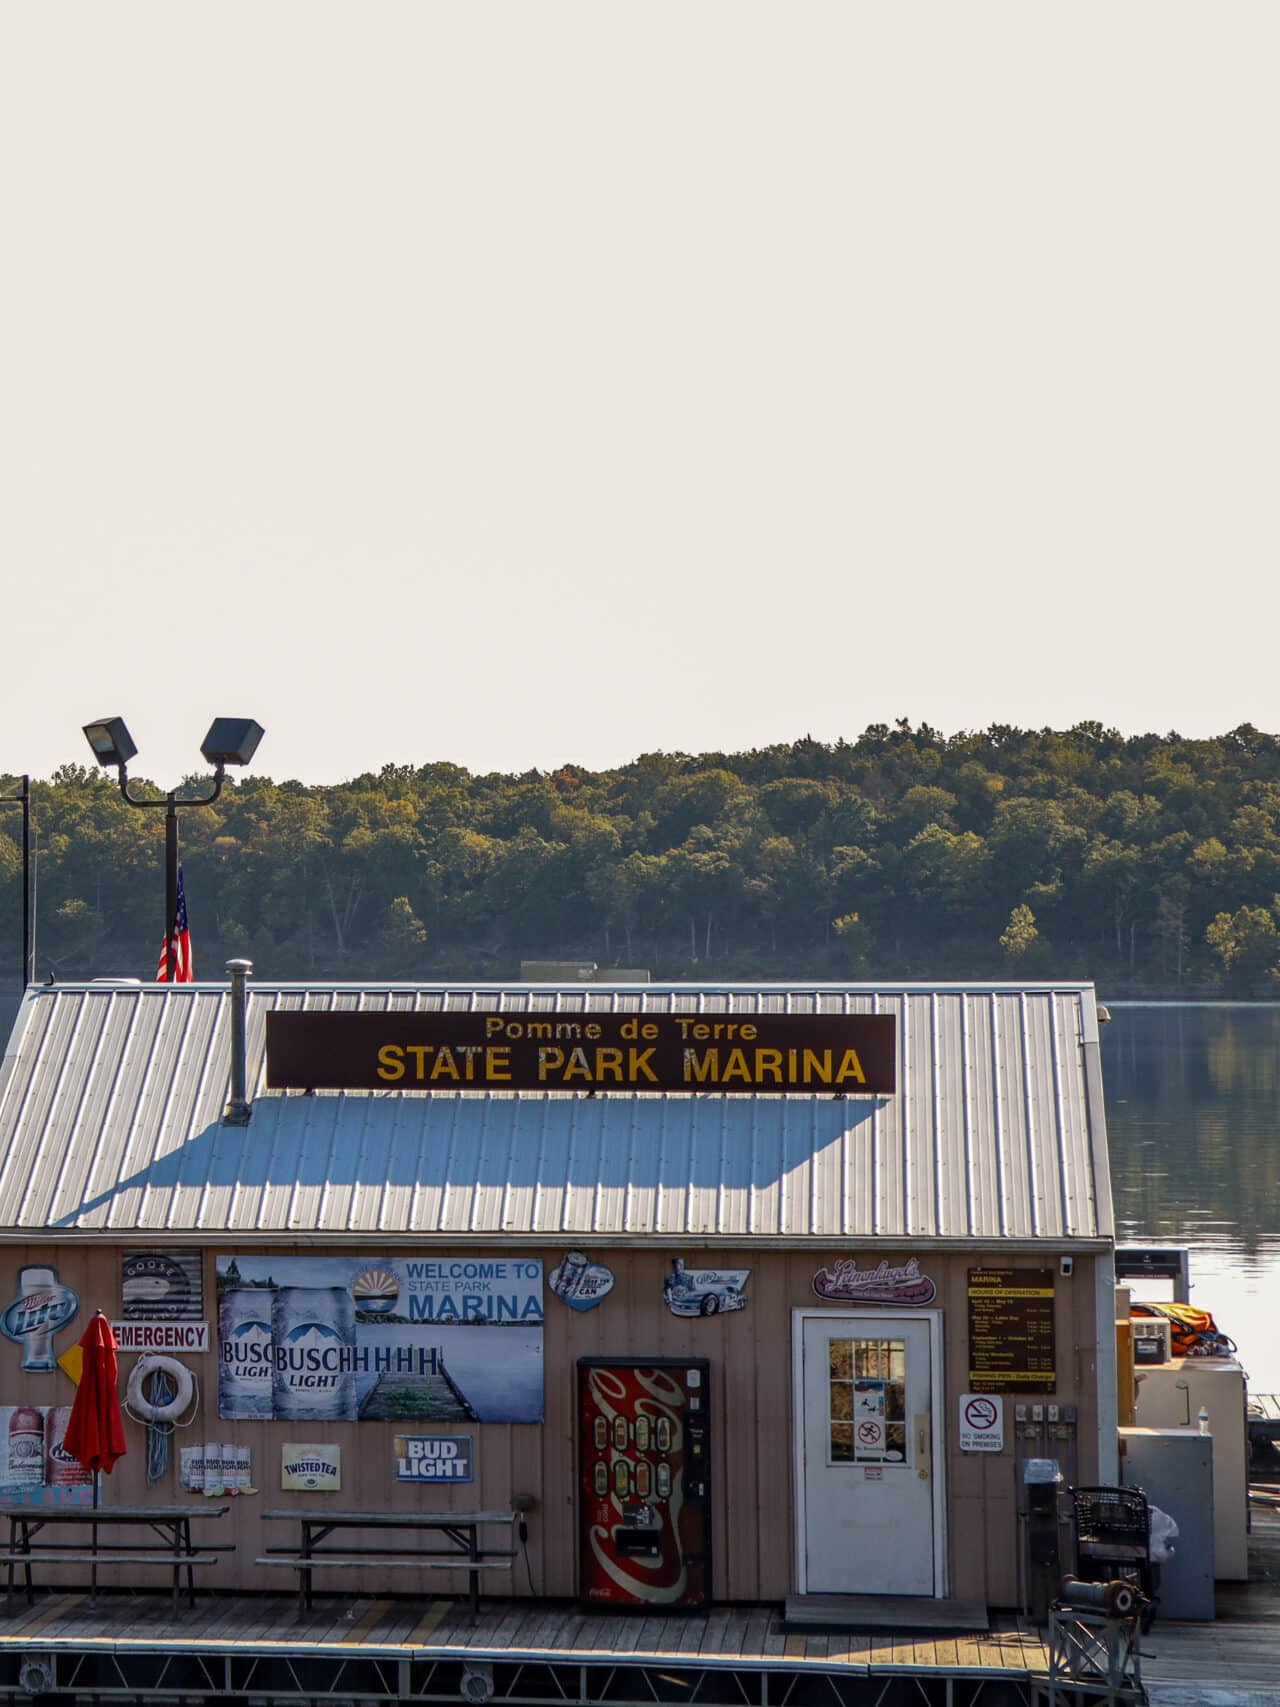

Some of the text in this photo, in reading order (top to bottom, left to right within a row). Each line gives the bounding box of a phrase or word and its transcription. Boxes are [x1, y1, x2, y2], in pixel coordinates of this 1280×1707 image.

[485, 1016, 758, 1041] Pomme de Terre
[376, 1045, 867, 1083] STATE PARK MARINA
[406, 1263, 507, 1279] WELCOME
[513, 1263, 540, 1279] TO
[407, 1281, 491, 1292] STATE PARK
[409, 1294, 544, 1319] MARINA
[112, 1327, 205, 1347] EMERGENCY
[223, 1342, 272, 1363] BUSC
[289, 1375, 338, 1388] LIGHT
[408, 1440, 458, 1459] BUD
[284, 1462, 320, 1475] TWISTED
[321, 1462, 337, 1476] TEA
[398, 1458, 468, 1476] LIGHT
